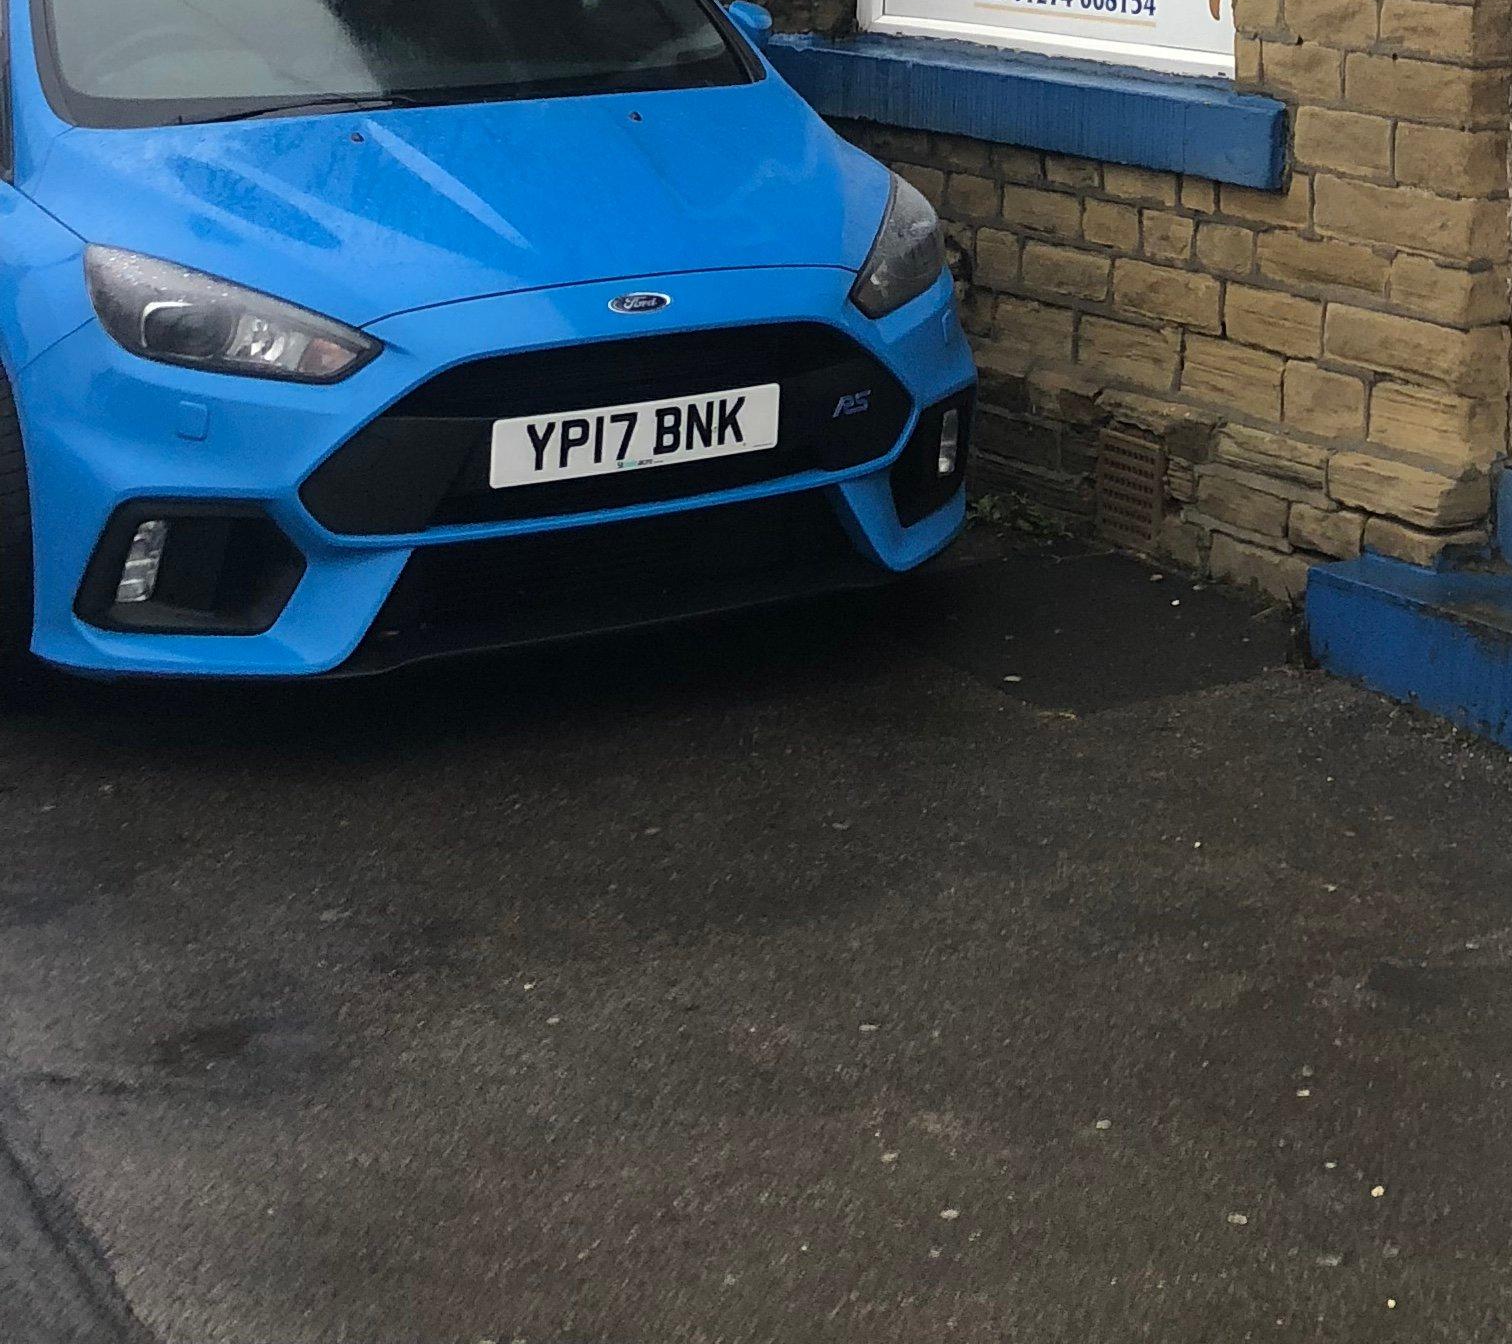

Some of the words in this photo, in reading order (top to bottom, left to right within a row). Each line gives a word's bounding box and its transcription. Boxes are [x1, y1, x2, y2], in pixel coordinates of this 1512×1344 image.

[623, 296, 657, 310] Ford
[832, 389, 871, 418] RS
[526, 412, 639, 472] YP17
[653, 395, 747, 456] BNK
